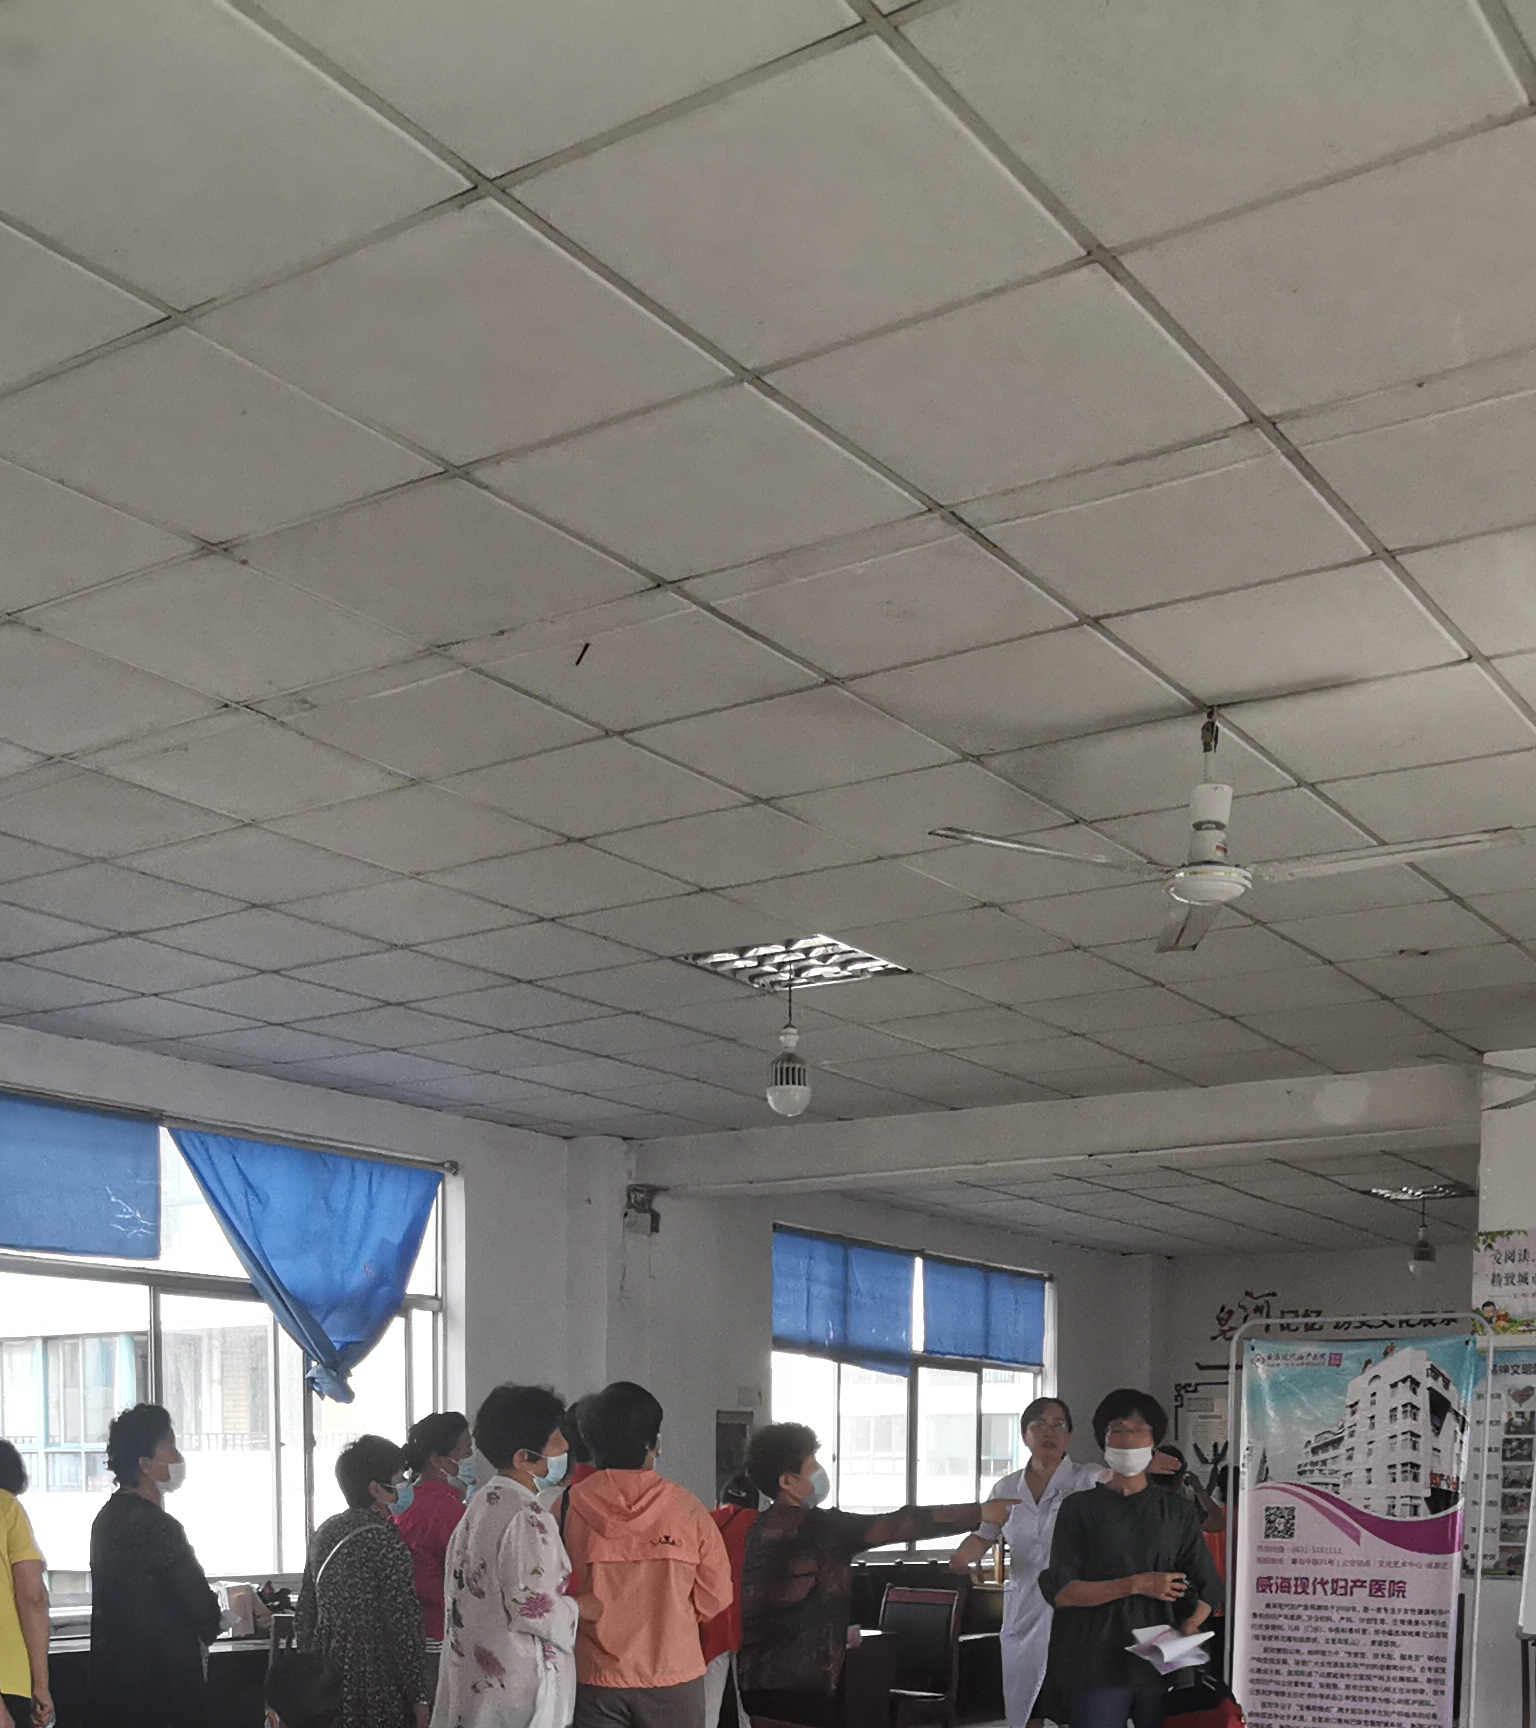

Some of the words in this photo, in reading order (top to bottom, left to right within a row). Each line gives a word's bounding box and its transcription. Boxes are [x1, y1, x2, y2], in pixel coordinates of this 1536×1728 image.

[1255, 1575, 1408, 1599] 威海现代妇产医院
